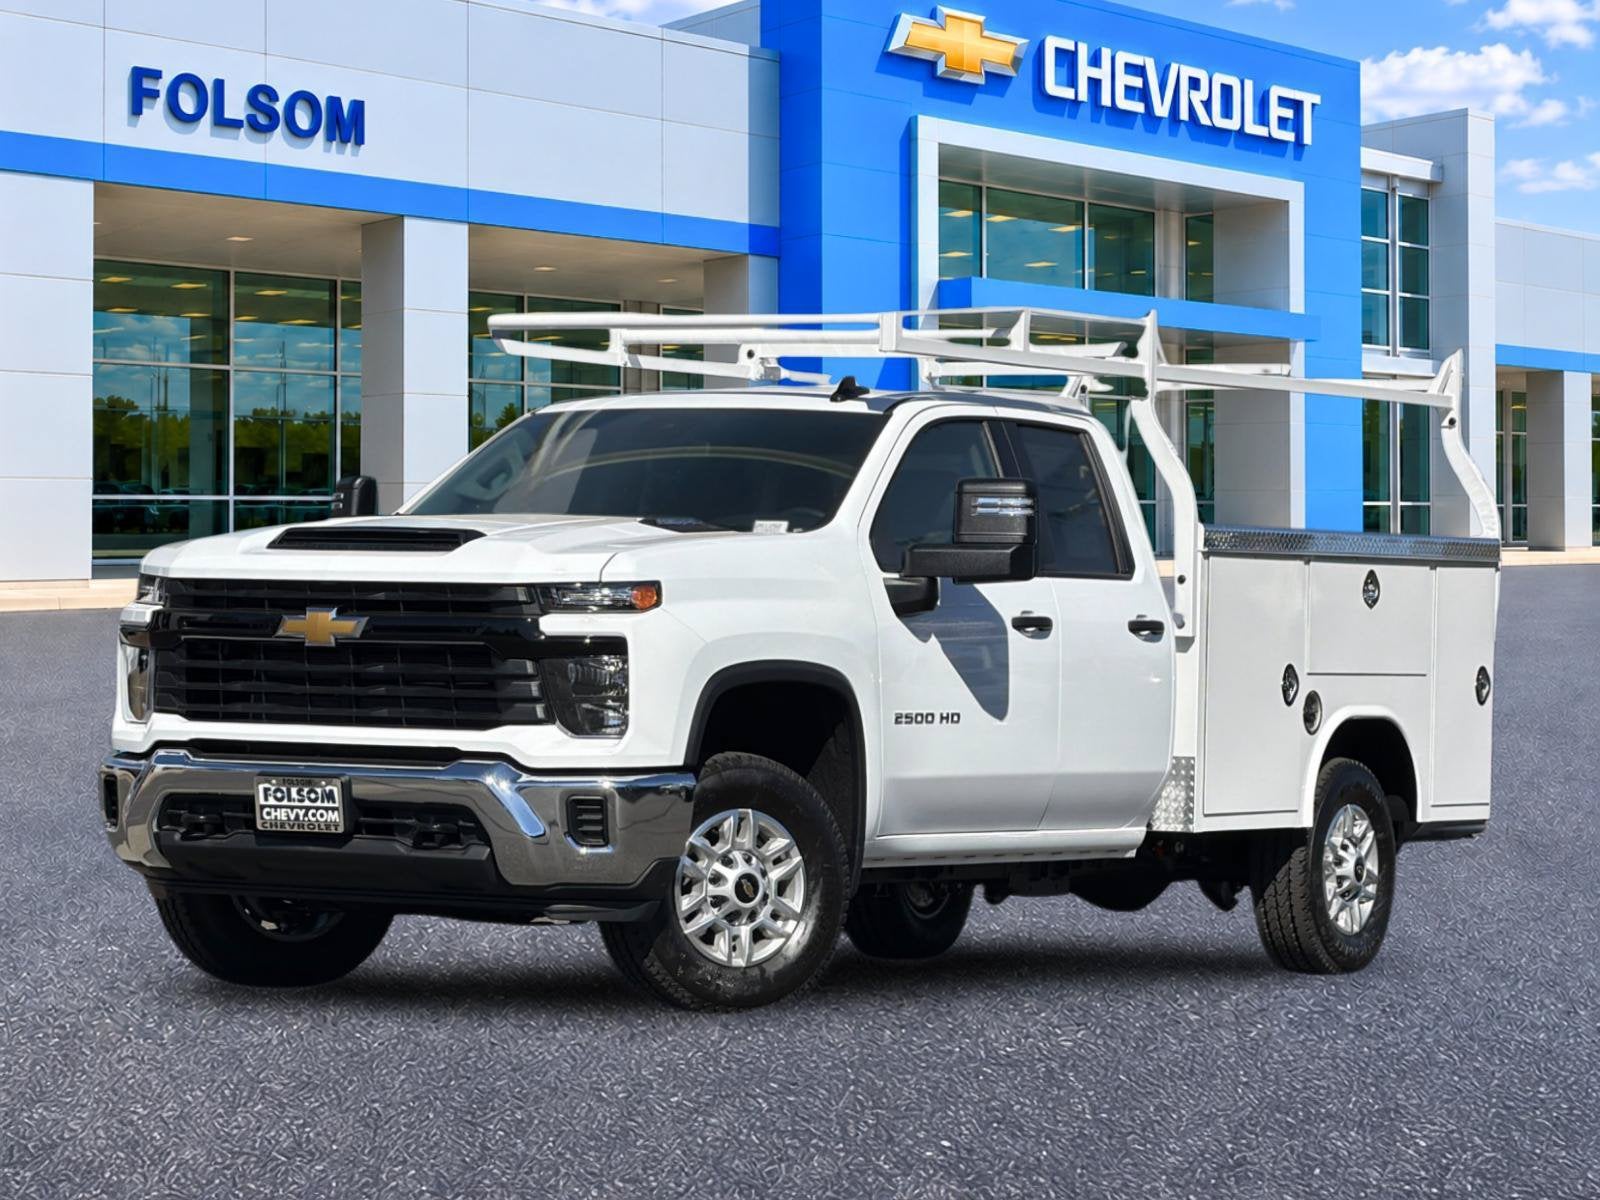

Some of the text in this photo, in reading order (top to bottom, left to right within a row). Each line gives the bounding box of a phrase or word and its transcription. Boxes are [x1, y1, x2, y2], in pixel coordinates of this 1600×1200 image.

[1043, 35, 1321, 146] CHEVROLET
[130, 65, 365, 146] FOLSOM
[894, 712, 961, 725] 2500 HD
[263, 786, 337, 804] FOLSOM
[262, 807, 340, 823] CHEVY.COM
[261, 821, 340, 831] CHEVROLET
